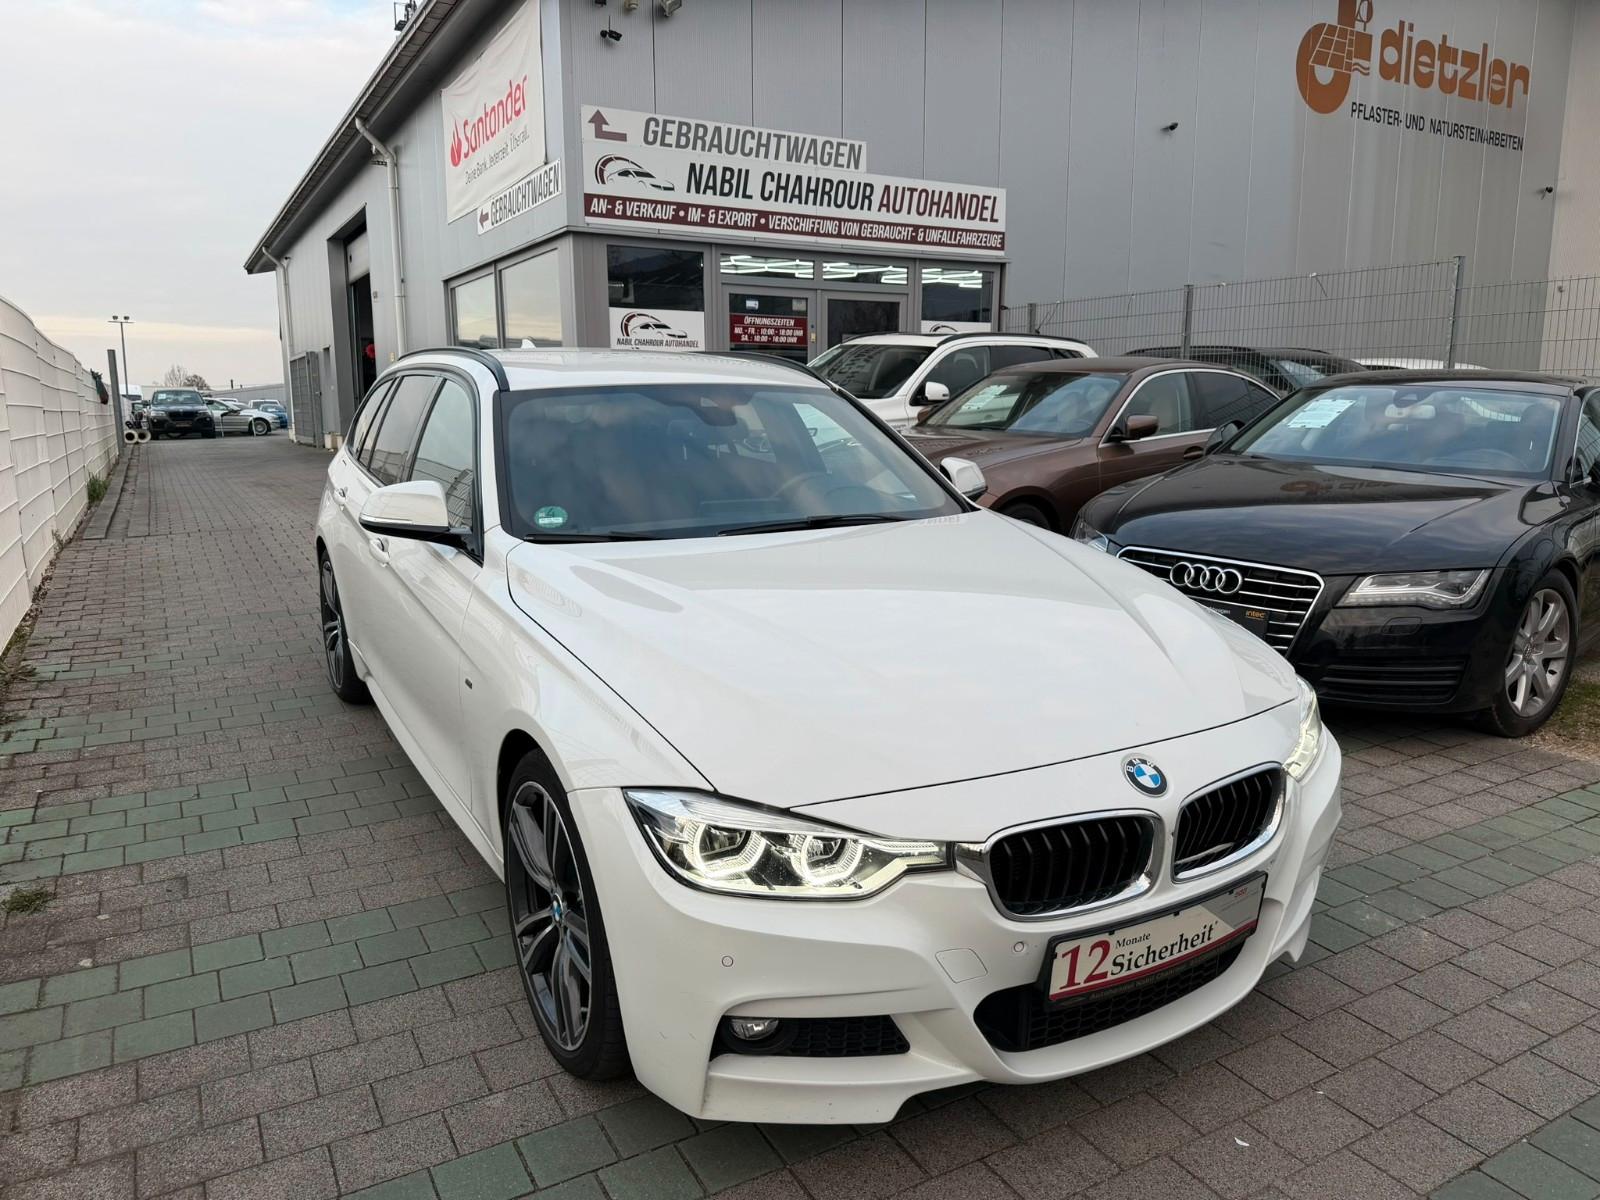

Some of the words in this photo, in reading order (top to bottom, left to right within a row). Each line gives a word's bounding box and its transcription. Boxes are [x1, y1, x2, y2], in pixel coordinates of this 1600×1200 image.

[1379, 20, 1530, 109] dietzler
[463, 74, 528, 159] Santander
[1350, 101, 1402, 127] PFLASTER-
[1405, 113, 1425, 132] UND
[1430, 118, 1524, 152] NATURSTEINARBEITEN
[642, 116, 862, 170] GEBRAUCHTWAGEN
[490, 166, 560, 226] GEBRAUCHTWAGEN
[686, 162, 753, 200] NABIL
[760, 171, 875, 212] CHAHROUR
[878, 184, 1000, 223] AUTOHANDEL
[590, 198, 612, 214] AN-
[615, 200, 623, 216] &
[626, 201, 676, 220] VERKAUF
[687, 209, 705, 223] IM-
[708, 211, 715, 224] &
[717, 211, 758, 228] EXPORT
[768, 215, 839, 235] VERSCHIFFUNG
[841, 220, 859, 236] VON
[861, 224, 915, 241] GEBRAUCHT-
[918, 228, 924, 241] &
[925, 228, 1002, 248] UNFALLFAHRZEUGE
[616, 338, 633, 346] NABIL
[634, 338, 664, 347] CHAHROUR
[665, 339, 699, 348] AUTOHANDEL
[743, 316, 795, 327] ÖFFNUNGSZEITEN
[1060, 939, 1111, 990] 12
[1115, 932, 1151, 949] Monate
